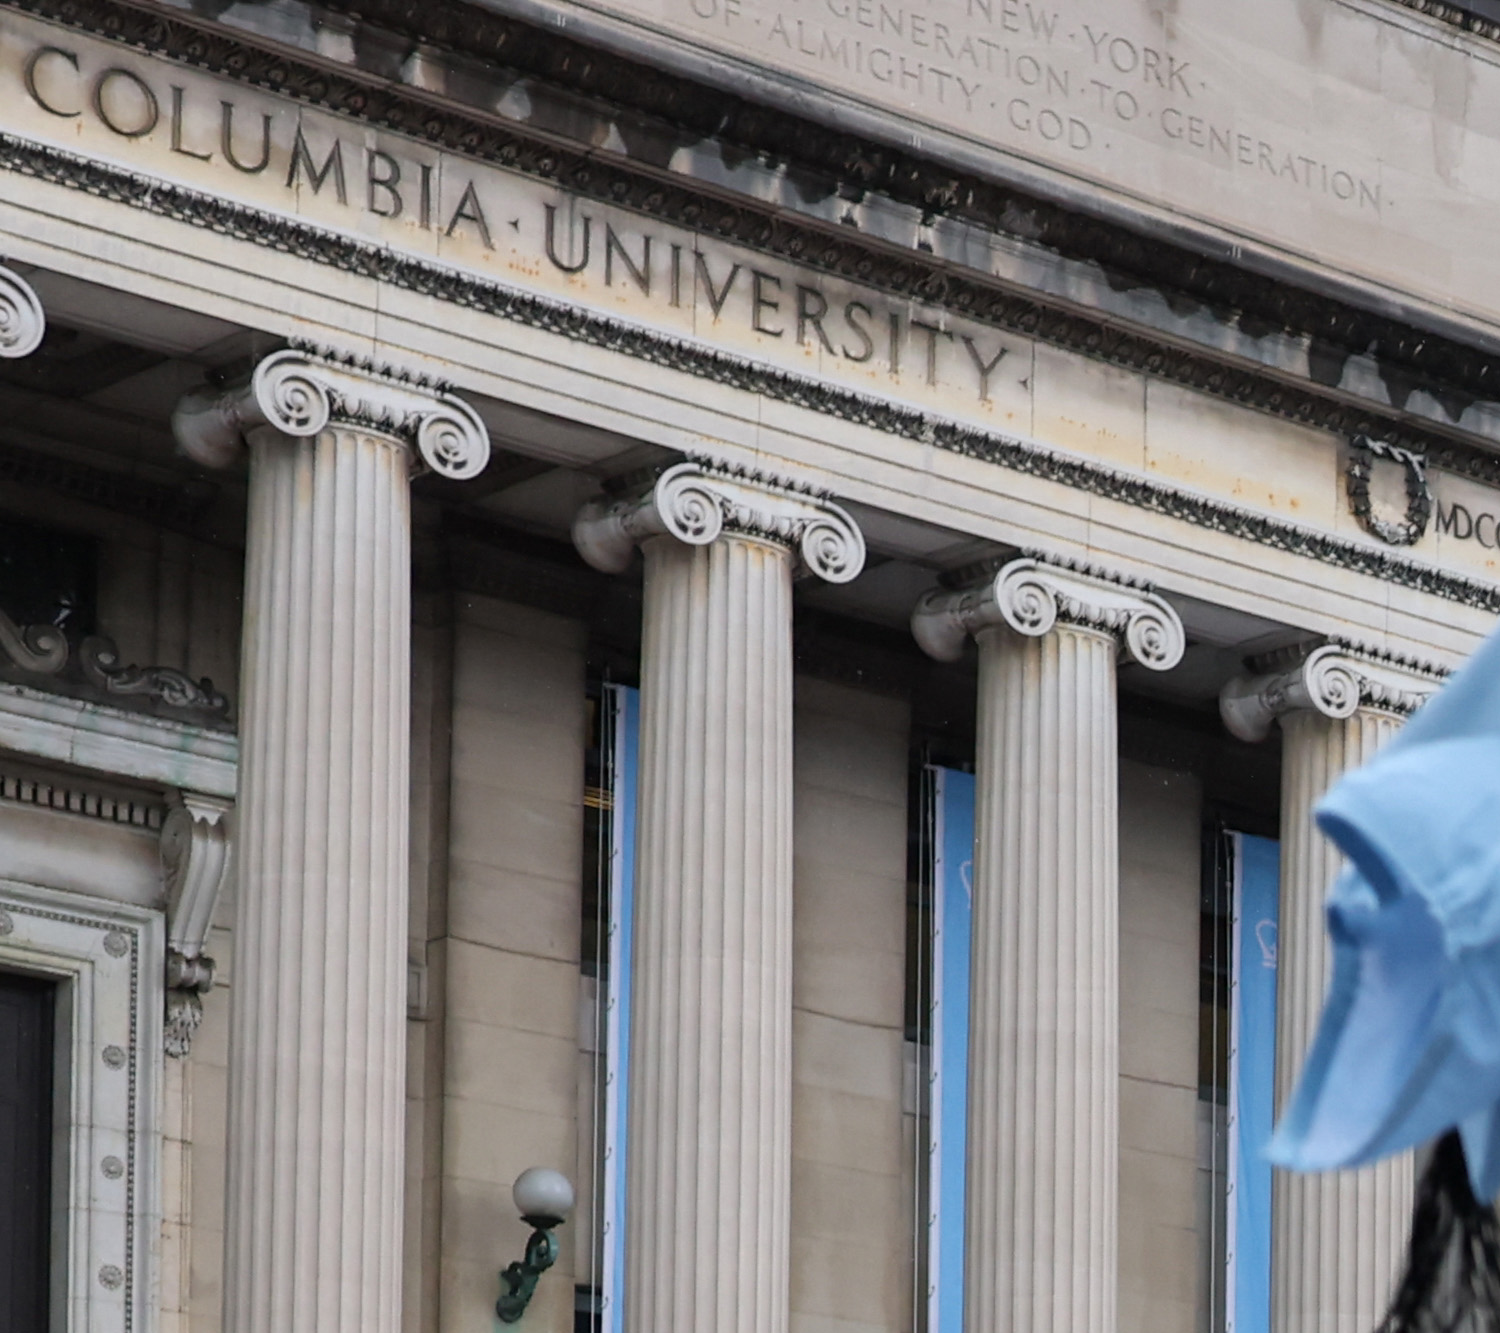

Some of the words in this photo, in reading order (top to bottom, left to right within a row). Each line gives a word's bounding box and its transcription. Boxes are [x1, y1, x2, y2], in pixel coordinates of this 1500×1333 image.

[768, 13, 982, 112] ALMIGHTY
[1006, 98, 1092, 151] GOD
[828, 0, 1069, 98] GENERATION
[1090, 79, 1140, 121] TO
[1160, 107, 1382, 210] GENERATION
[1083, 24, 1193, 98] YORK
[22, 45, 497, 252] COLUMBIA
[544, 202, 1006, 401] UNIVERSITY
